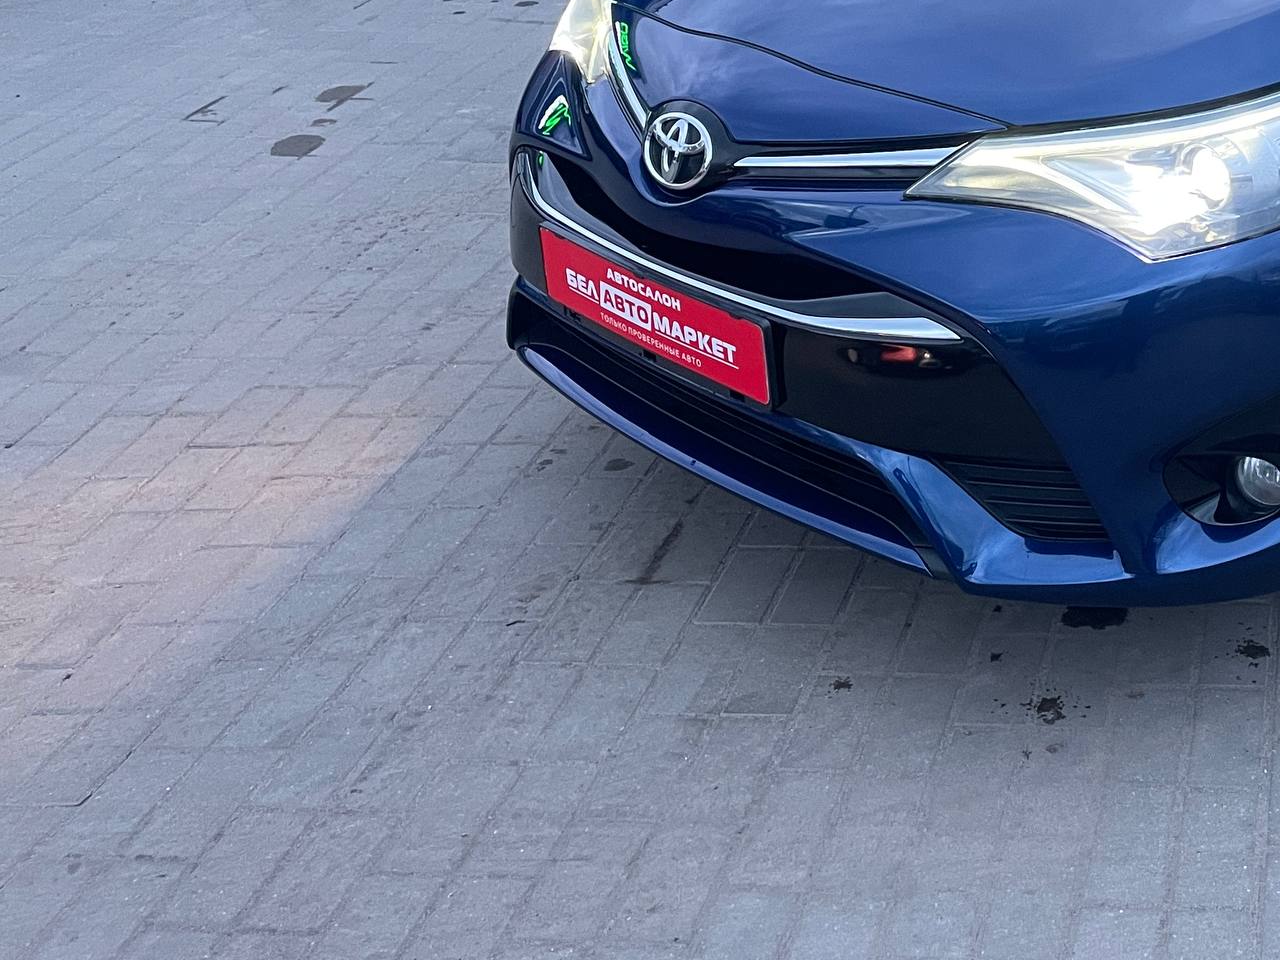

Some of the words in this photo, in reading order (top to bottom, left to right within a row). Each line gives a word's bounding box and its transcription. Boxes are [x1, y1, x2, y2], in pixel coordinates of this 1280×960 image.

[565, 267, 599, 301] БЕЛ
[603, 293, 649, 323] АВТО
[652, 312, 737, 364] МАРКЕТ
[606, 268, 681, 312] АВТОСАЛОН
[601, 312, 627, 332] ТОЛЬКО
[628, 326, 680, 360] ПРОВЕРЕННЫЕ
[681, 354, 702, 368] АВТО
